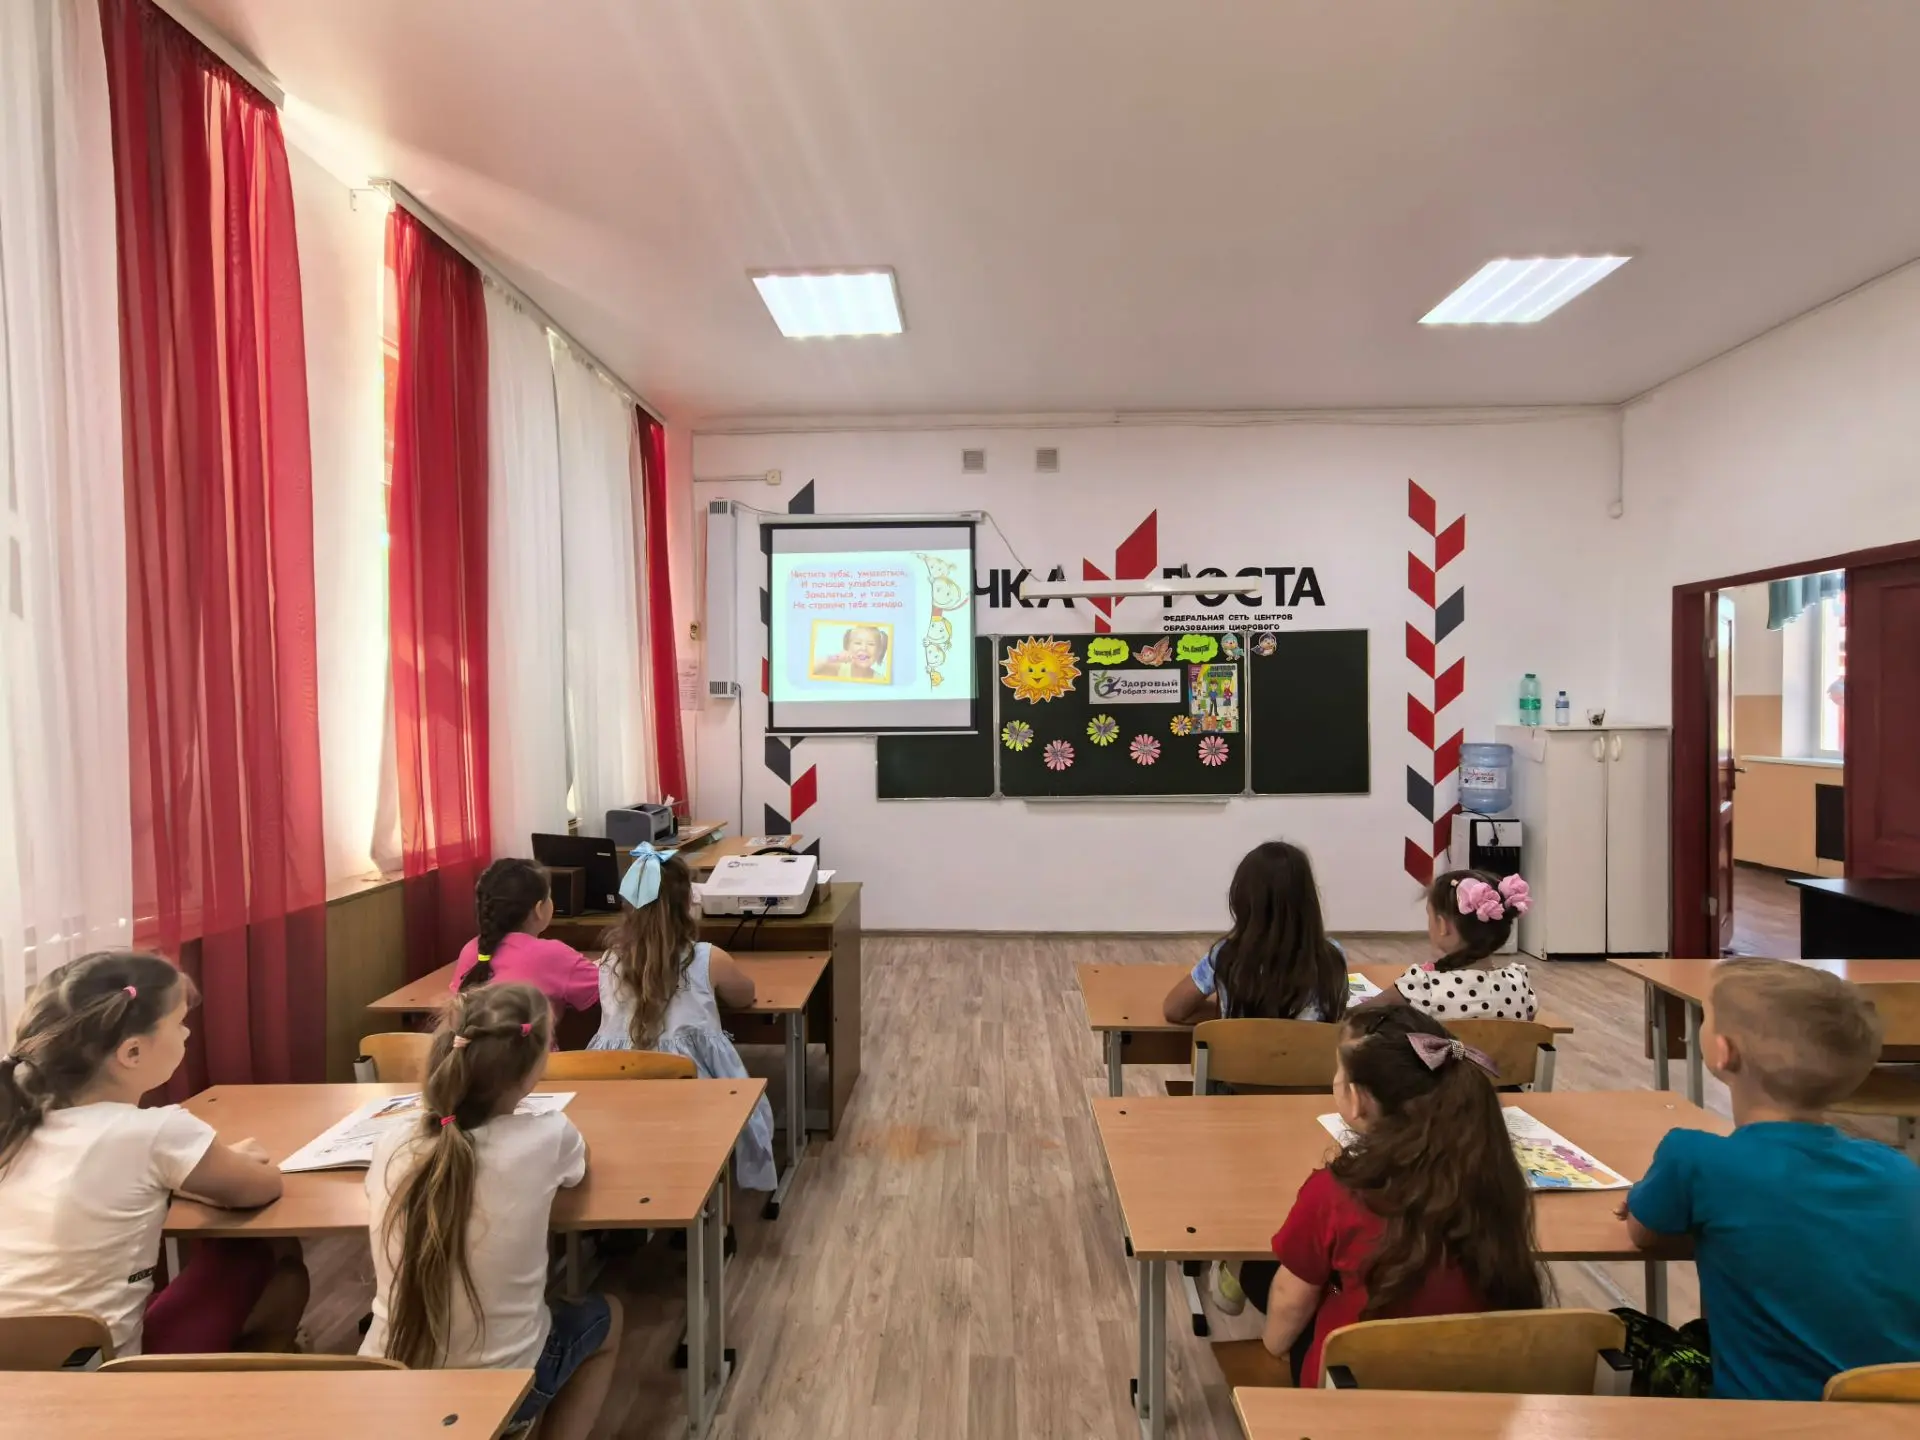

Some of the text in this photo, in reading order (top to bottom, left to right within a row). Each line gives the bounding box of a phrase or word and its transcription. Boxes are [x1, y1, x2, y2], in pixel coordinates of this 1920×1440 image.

[801, 580, 808, 588] И
[1163, 614, 1225, 622] ФЕДЕРАЛЬНАЯ
[1254, 613, 1293, 621] ЦЕНТРОВ
[1163, 623, 1280, 632] ОБРАЗОВАНИЯ ЦИФРОВОГО
[1120, 679, 1178, 688] Здоровый
